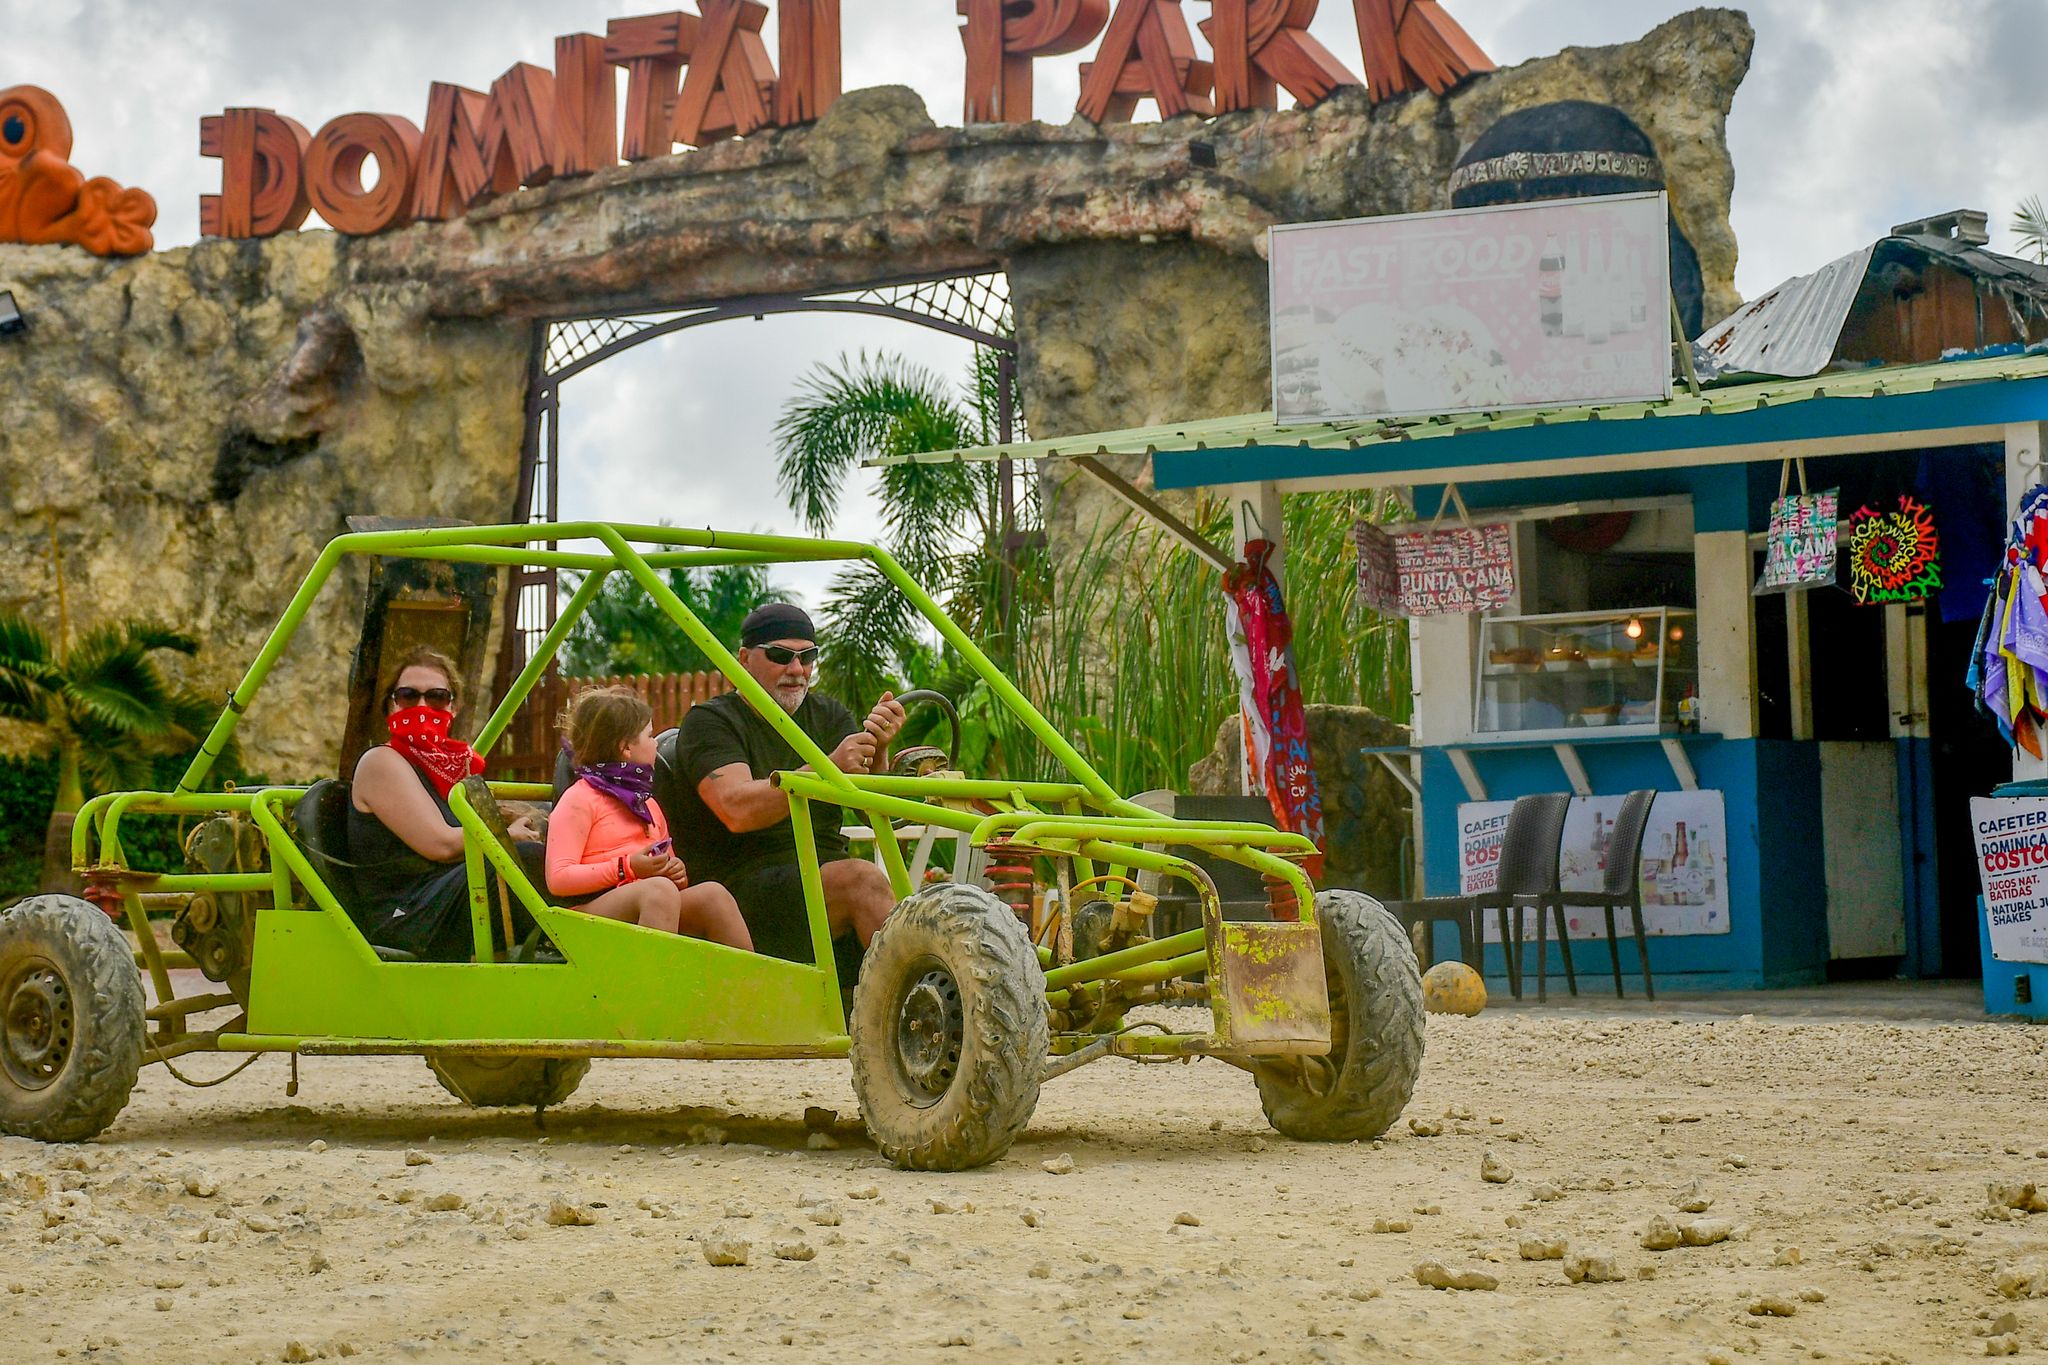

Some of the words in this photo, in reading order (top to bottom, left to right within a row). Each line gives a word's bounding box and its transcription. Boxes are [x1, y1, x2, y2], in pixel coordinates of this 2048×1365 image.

[957, 0, 1497, 124] PARK
[1291, 240, 1398, 294] FAST
[1407, 234, 1534, 282] FOOD
[1400, 571, 1459, 594] PUNTA
[1462, 567, 1513, 590] CANA
[1397, 593, 1436, 609] PUNTA
[1438, 590, 1473, 605] CANA
[1466, 869, 1494, 884] JUGOS
[1988, 878, 2017, 892] JUGOS
[2018, 874, 2040, 886] NAT.
[1989, 885, 2033, 902] BATIDAS
[1991, 899, 2038, 916] NATURAL
[1993, 910, 2032, 927] SHAKES
